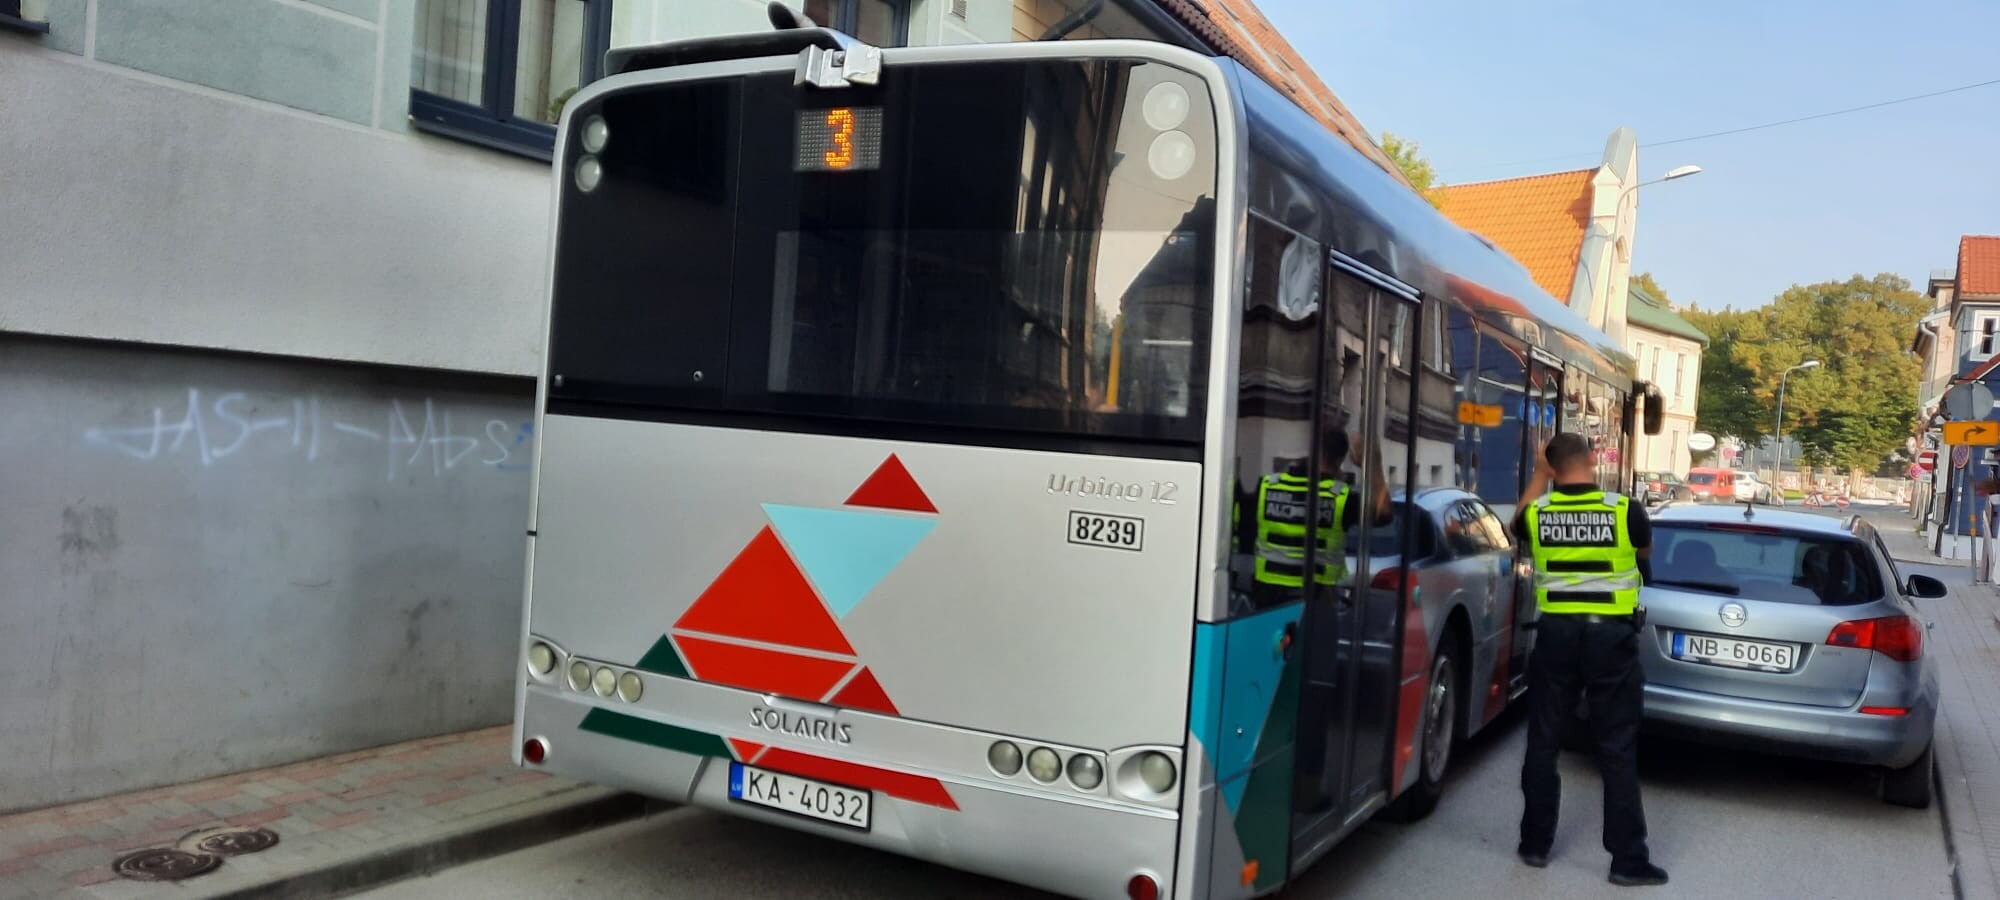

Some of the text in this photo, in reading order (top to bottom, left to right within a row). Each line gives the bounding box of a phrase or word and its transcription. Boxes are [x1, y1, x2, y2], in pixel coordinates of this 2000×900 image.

[826, 108, 853, 168] 3
[1047, 473, 1178, 505] Urbino 12
[1075, 516, 1136, 545] 8239
[1540, 511, 1615, 525] PAŠVALDĪBAS
[1540, 526, 1614, 541] POLICIJA
[1689, 638, 1787, 665] NB-6066
[750, 707, 851, 746] SOLARIS
[749, 771, 864, 822] KA-4032
